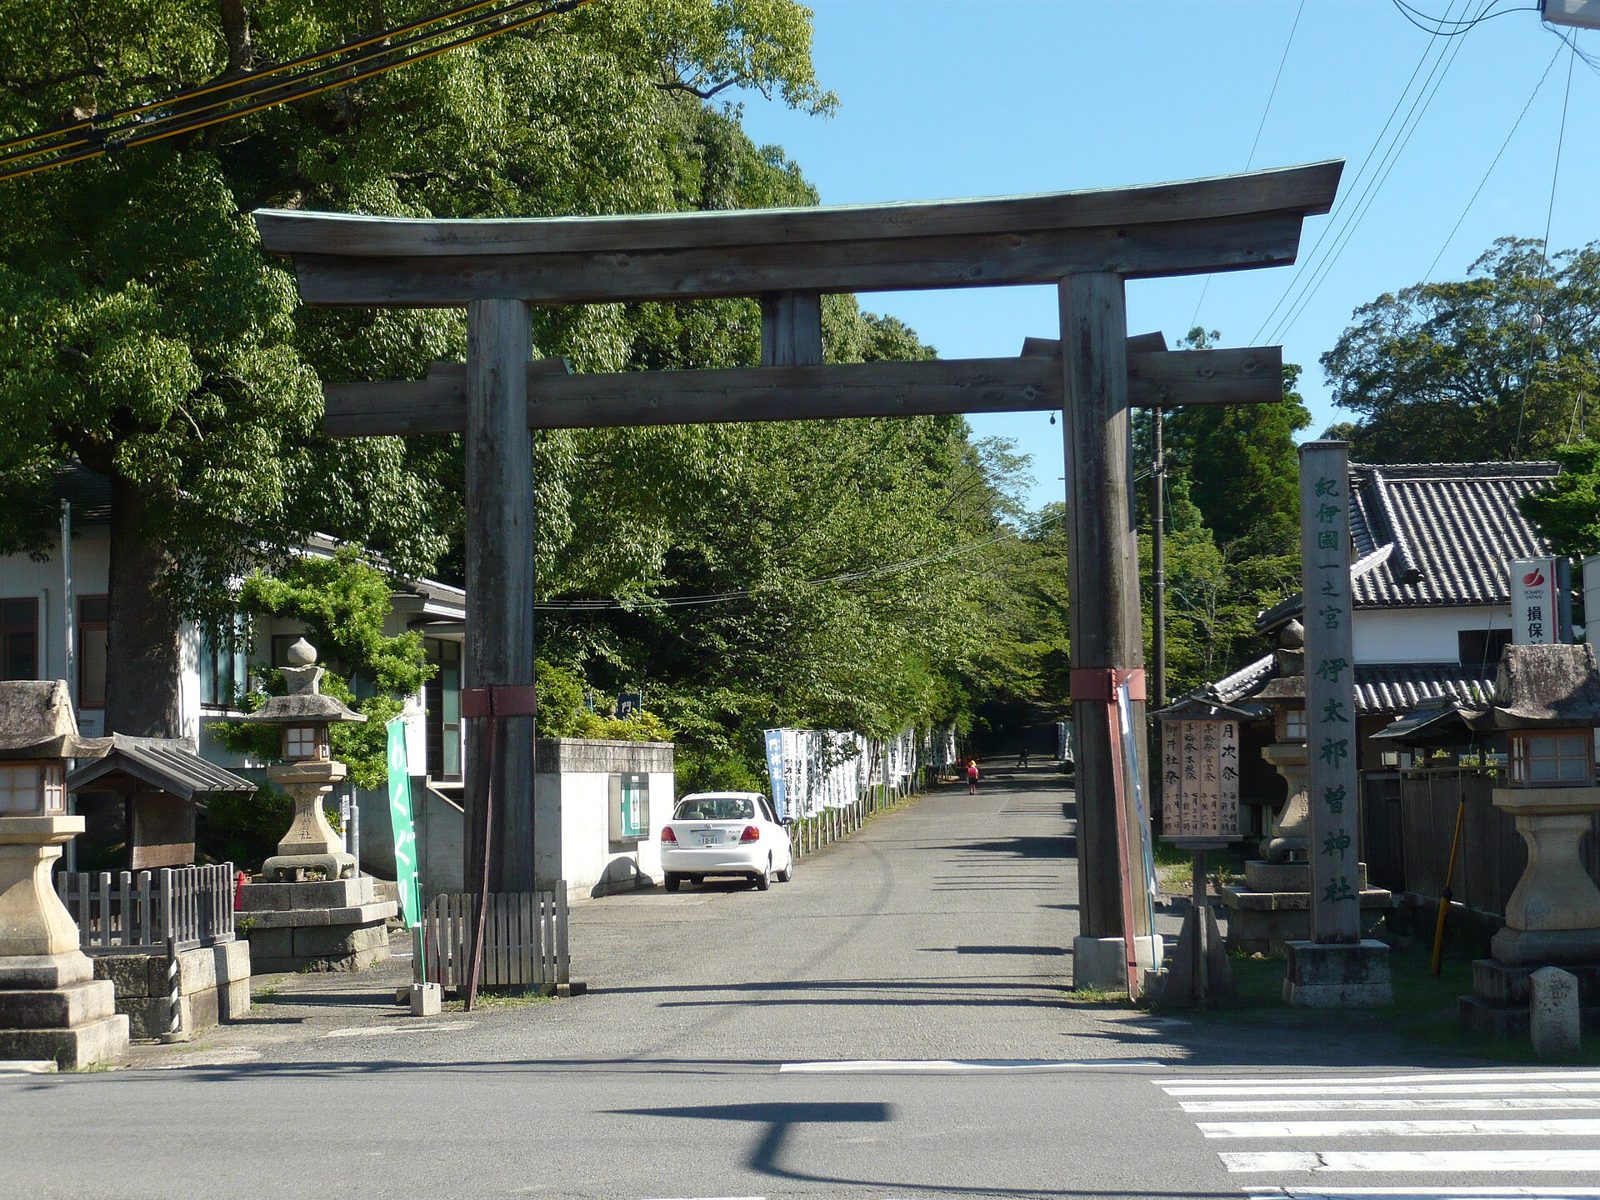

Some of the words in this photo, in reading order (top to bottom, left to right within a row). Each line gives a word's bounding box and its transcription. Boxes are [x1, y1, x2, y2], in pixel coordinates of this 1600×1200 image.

[1314, 476, 1343, 631] 紀伊國一之宮
[1527, 606, 1544, 644] 損保
[1221, 724, 1240, 781] 月次祭
